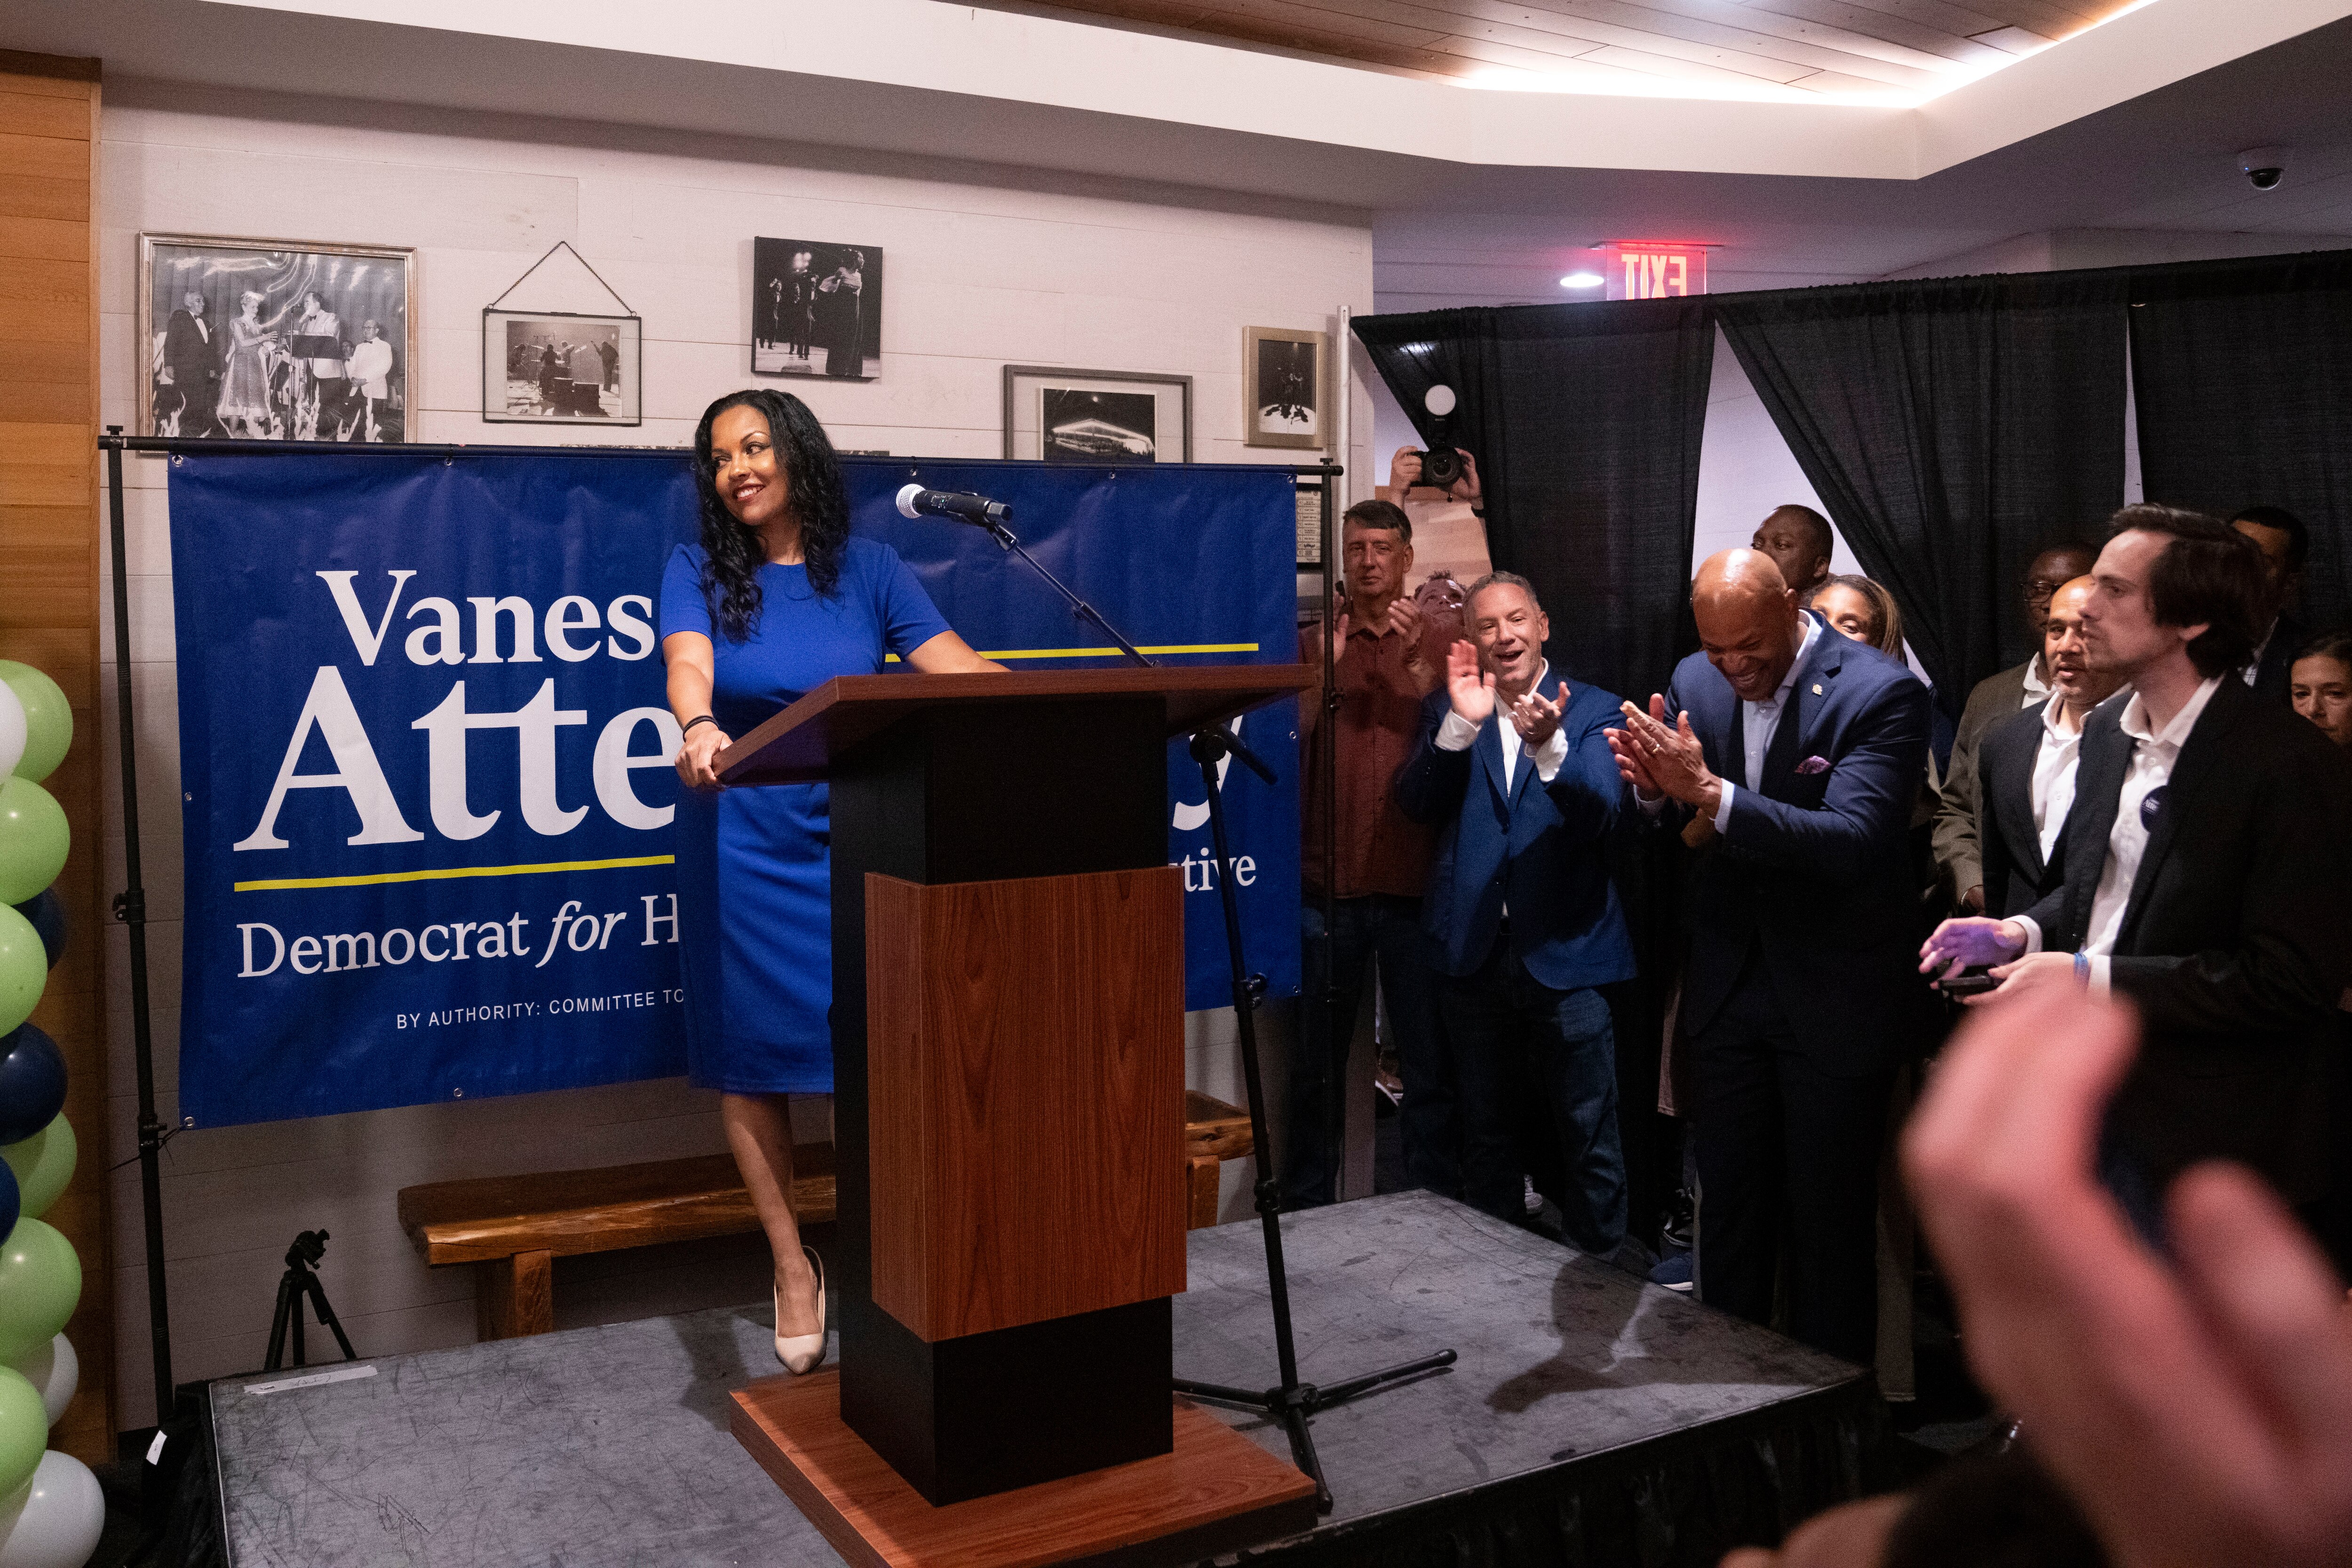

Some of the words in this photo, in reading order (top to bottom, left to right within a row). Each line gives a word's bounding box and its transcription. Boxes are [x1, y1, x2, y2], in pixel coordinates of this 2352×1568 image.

[316, 570, 655, 665] Vanes
[234, 665, 682, 852] Atte
[237, 912, 531, 978] Democrat
[535, 900, 628, 967] for
[397, 1013, 421, 1029] BY
[429, 1002, 540, 1027] AUTHORITY:
[549, 991, 655, 1014] COMMITTEE
